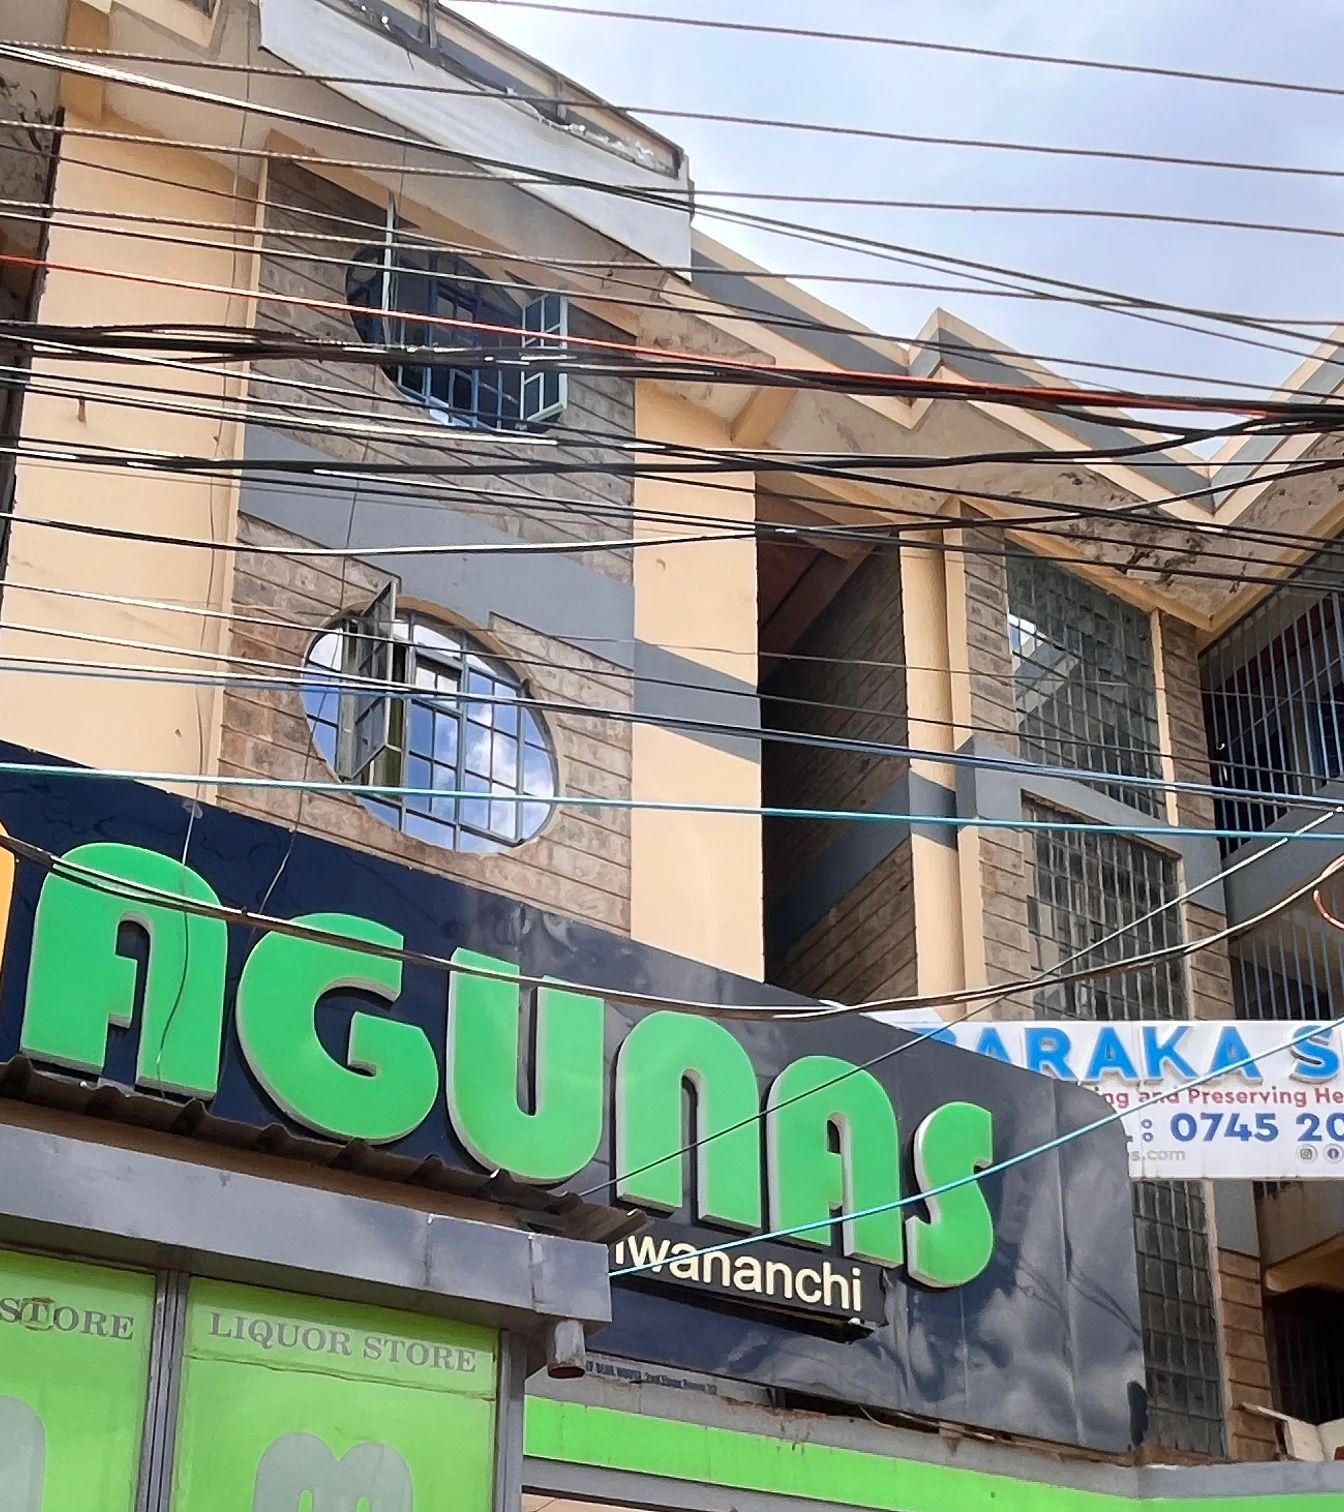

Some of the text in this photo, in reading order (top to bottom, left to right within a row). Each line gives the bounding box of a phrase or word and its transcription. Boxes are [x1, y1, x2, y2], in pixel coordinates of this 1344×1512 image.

[1139, 1086, 1180, 1105] and
[1189, 1086, 1306, 1108] Preserving
[1170, 1112, 1278, 1142] 0745
[1131, 1149, 1186, 1161] s.com
[209, 1311, 477, 1374] LIQUOR STORE
